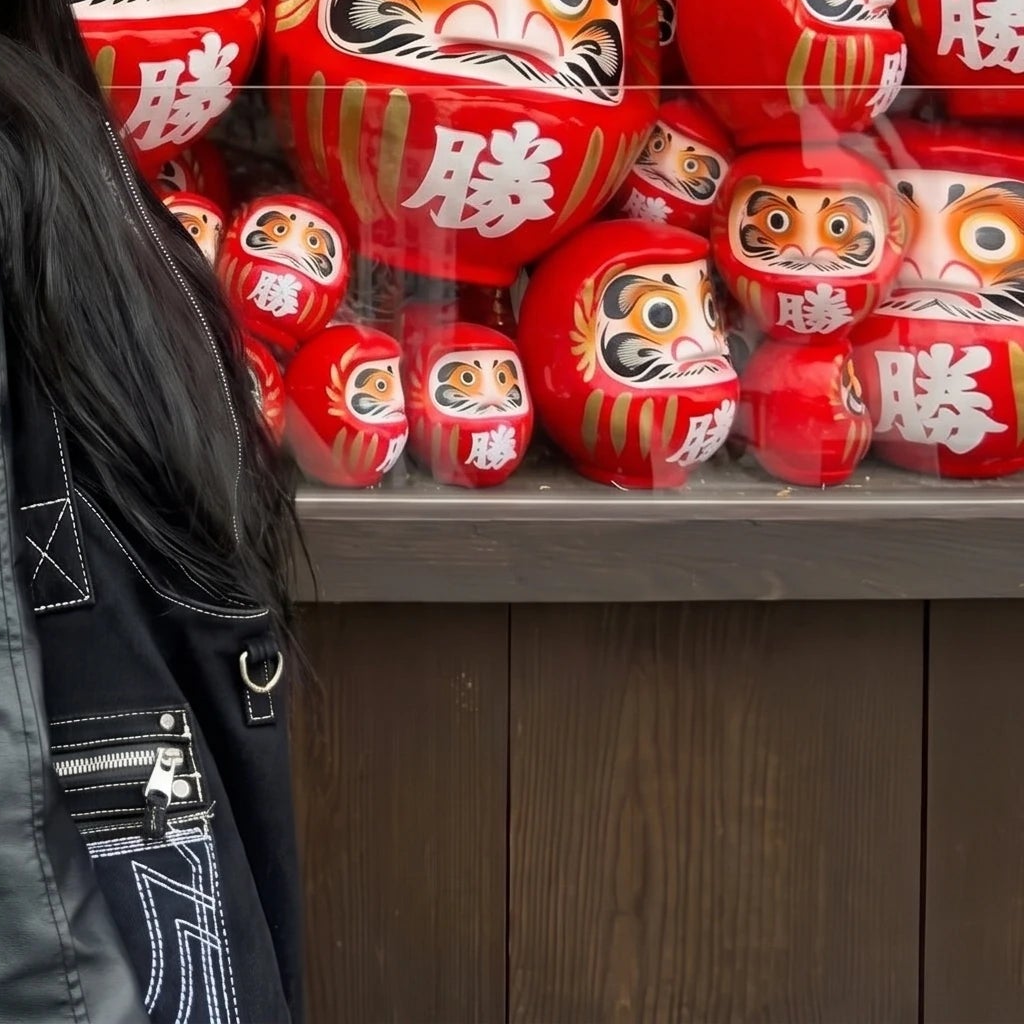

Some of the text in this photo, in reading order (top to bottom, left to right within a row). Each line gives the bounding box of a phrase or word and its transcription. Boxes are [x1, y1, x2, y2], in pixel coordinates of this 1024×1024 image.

[119, 32, 239, 151] 勝
[402, 121, 563, 238] 勝
[777, 284, 854, 334] 勝
[666, 399, 735, 466] 勝
[875, 344, 1008, 454] 勝
[465, 424, 517, 470] 勝
